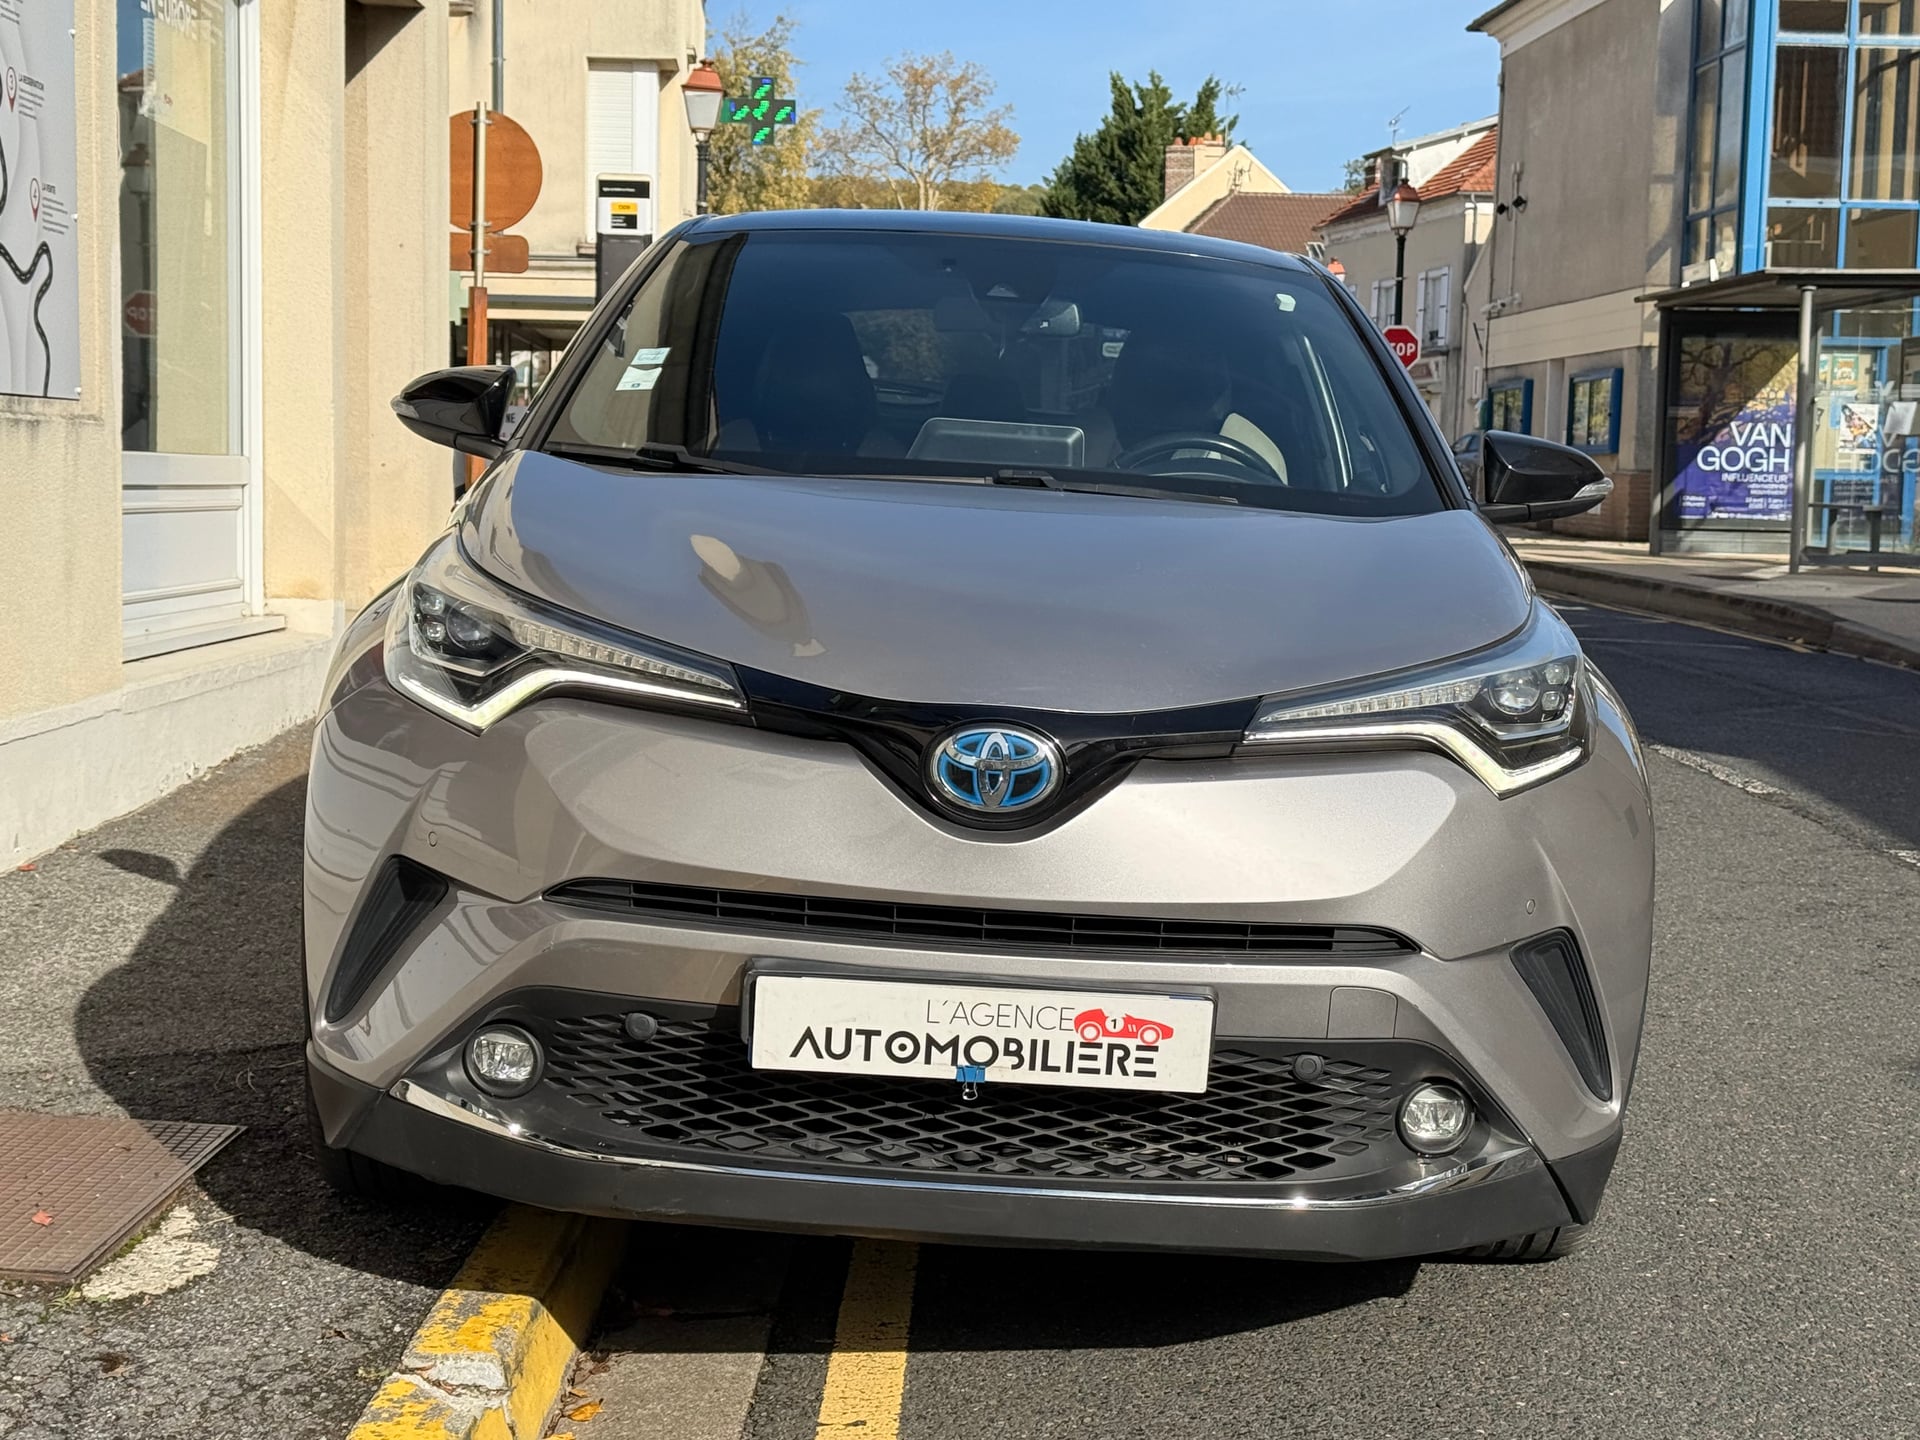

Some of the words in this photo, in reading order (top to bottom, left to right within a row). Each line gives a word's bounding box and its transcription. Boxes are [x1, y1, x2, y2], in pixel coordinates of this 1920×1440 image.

[1730, 422, 1791, 448] VAN
[1696, 445, 1790, 473] GOGH
[1721, 473, 1789, 484] INFLUENCEUR
[926, 999, 1076, 1032] L'AGENCE
[1110, 1018, 1118, 1030] 1
